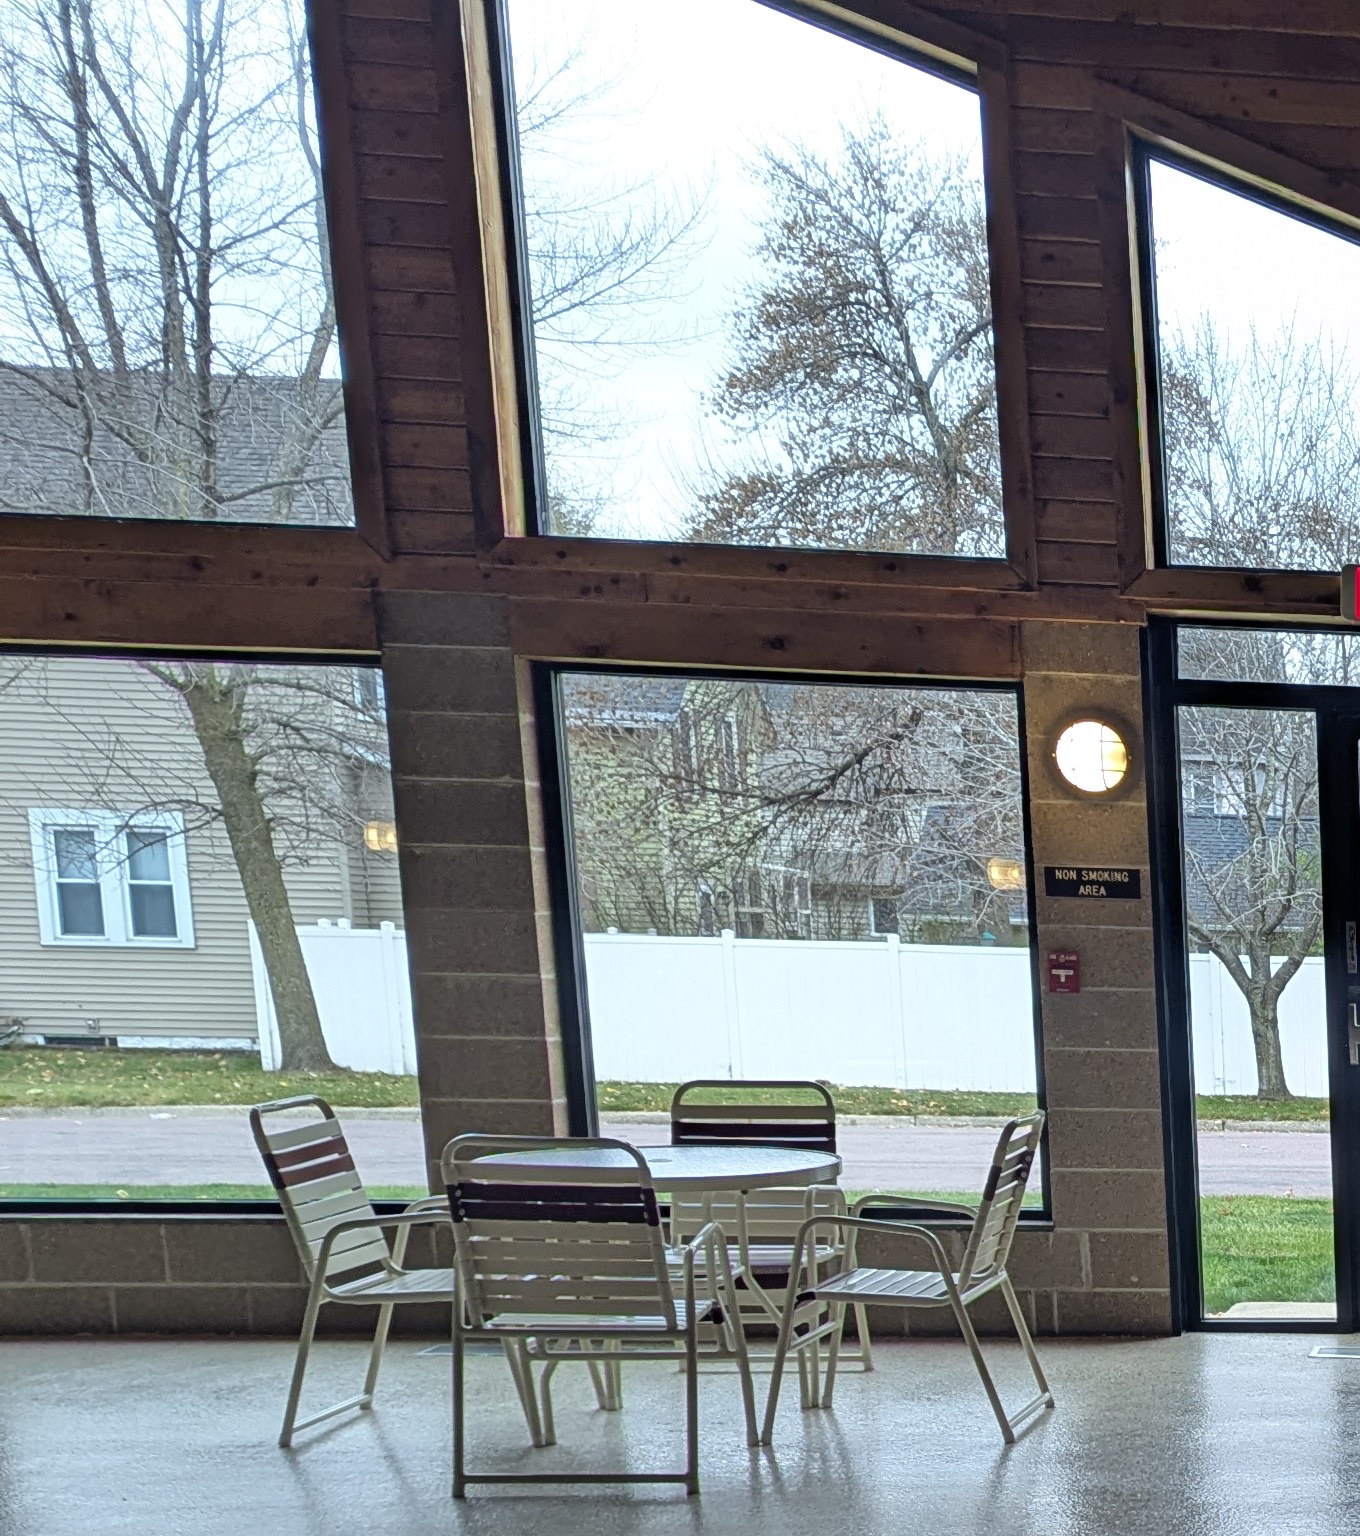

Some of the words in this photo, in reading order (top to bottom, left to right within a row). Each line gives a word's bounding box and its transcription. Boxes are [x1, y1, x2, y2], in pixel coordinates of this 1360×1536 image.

[1055, 869, 1077, 880] NON
[1081, 870, 1129, 882] SMOKING
[1078, 885, 1107, 896] AREA
